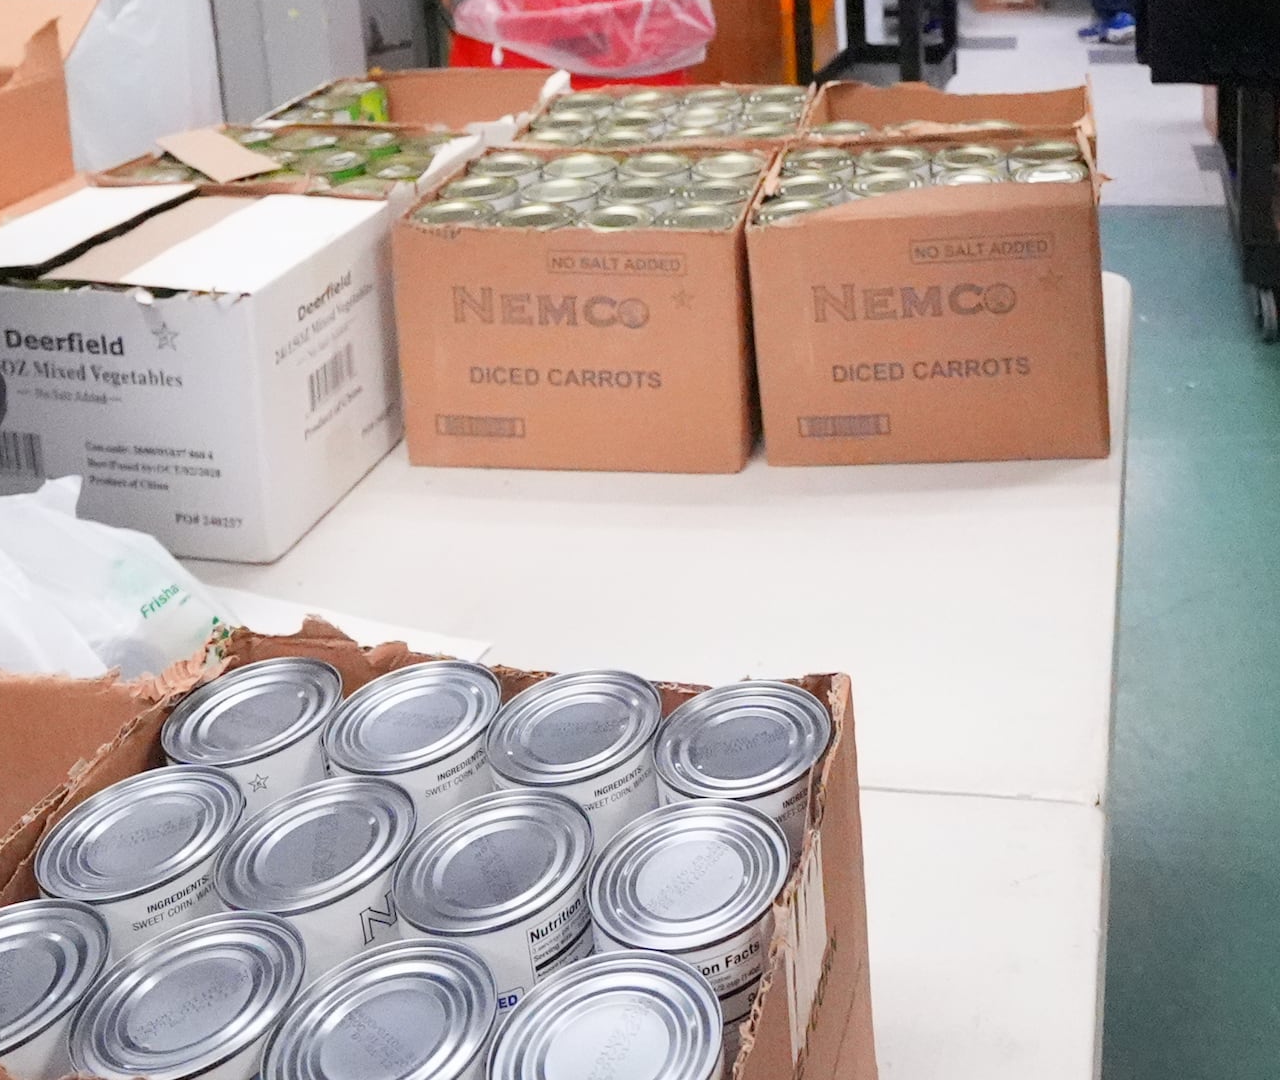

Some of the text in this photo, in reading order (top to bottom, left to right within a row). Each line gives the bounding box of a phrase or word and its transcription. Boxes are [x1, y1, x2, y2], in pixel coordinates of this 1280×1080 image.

[914, 239, 1048, 259] NO SALT ADDED
[551, 256, 681, 272] NO SALT ADDED
[297, 270, 352, 321] Deerfield
[4, 329, 125, 356] Deerfield
[33, 360, 86, 381] Mixed
[90, 364, 183, 387] Vegetables
[470, 366, 663, 390] DICED CARROTS
[832, 356, 1031, 383] DICED CARROTS
[424, 781, 452, 798] SWEET
[131, 913, 166, 932] SWEET
[530, 898, 581, 943] Nutrition
[725, 941, 760, 969] Facts
[498, 994, 518, 1010] ED
